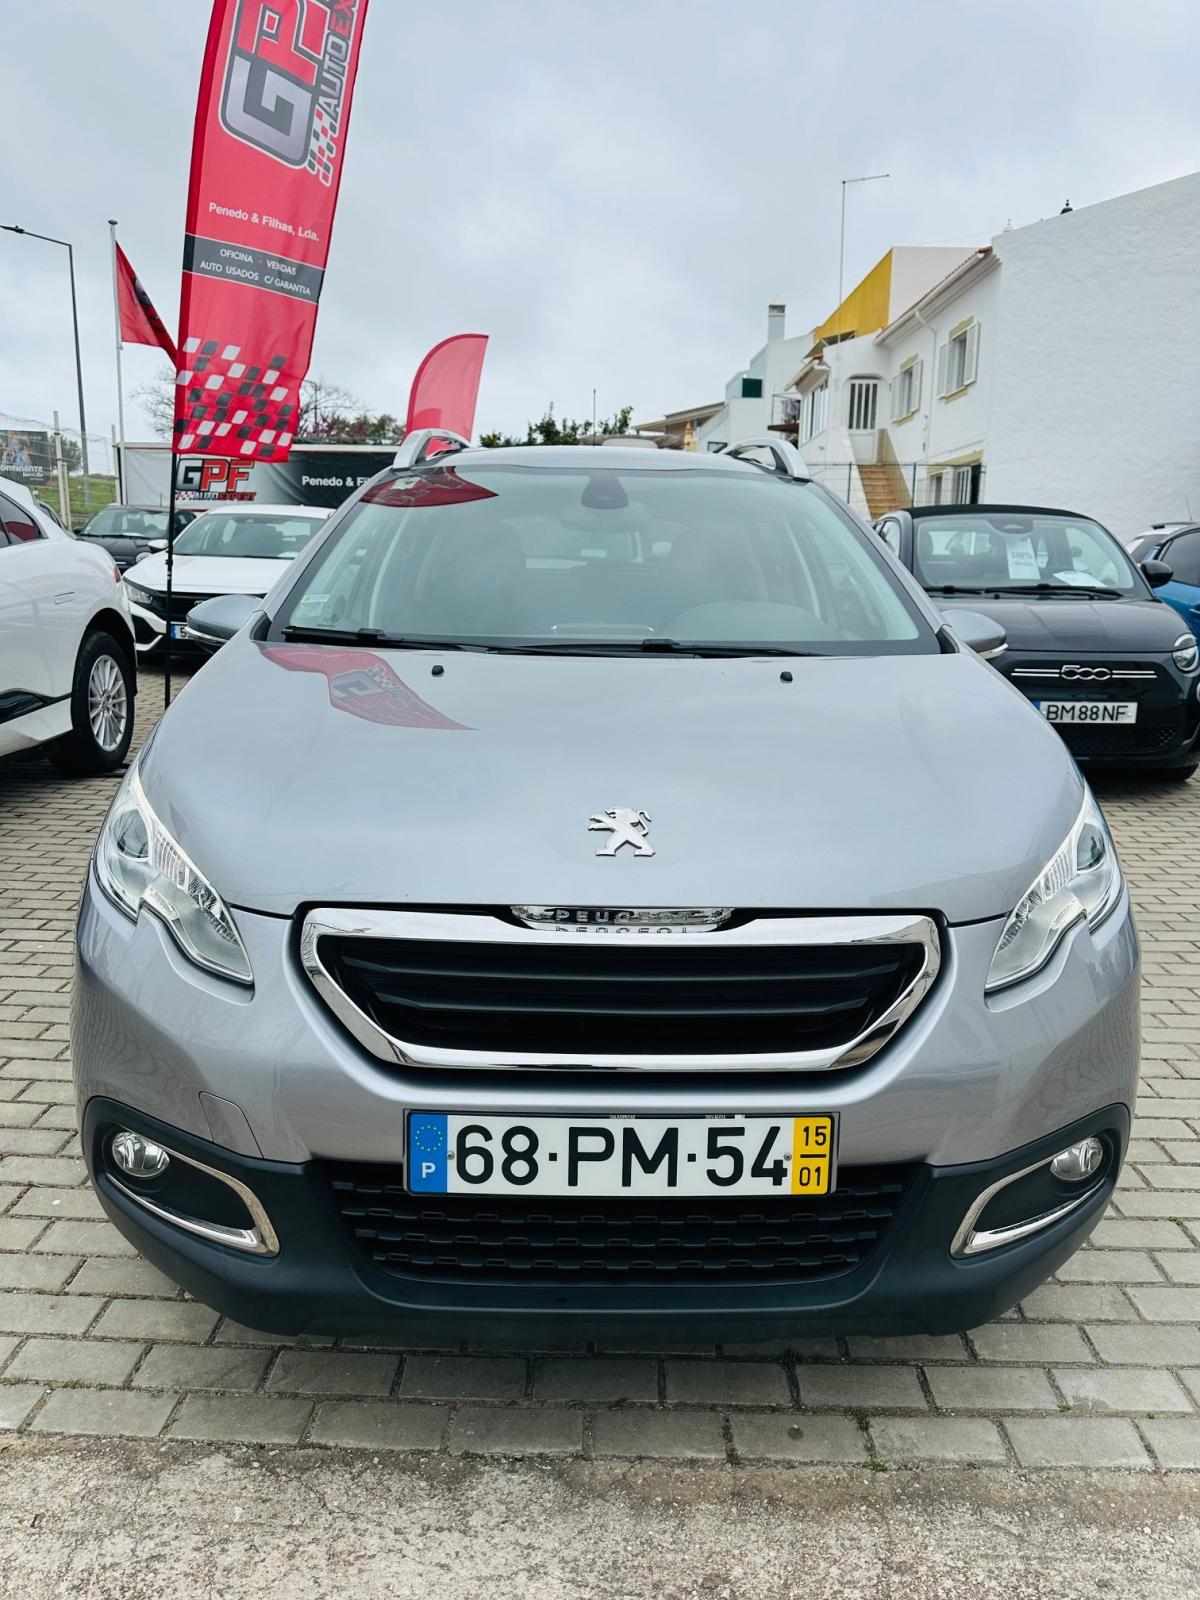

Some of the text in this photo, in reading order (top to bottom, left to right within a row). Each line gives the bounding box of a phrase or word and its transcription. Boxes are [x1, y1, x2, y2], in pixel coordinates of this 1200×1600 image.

[209, 202, 320, 241] Penedo & Filhas, Lda.
[199, 260, 222, 273] AUTO
[226, 266, 259, 281] USADOS
[219, 248, 297, 275] OFICINA VENDAS
[175, 457, 256, 492] GPF
[302, 475, 343, 487] Penedo
[345, 476, 354, 487] &
[1059, 665, 1112, 681] 500
[1045, 704, 1128, 721] BM88NF
[556, 909, 690, 923] PEUGEOT
[802, 1125, 827, 1147] 15
[421, 1163, 436, 1179] P
[799, 1166, 823, 1187] 01
